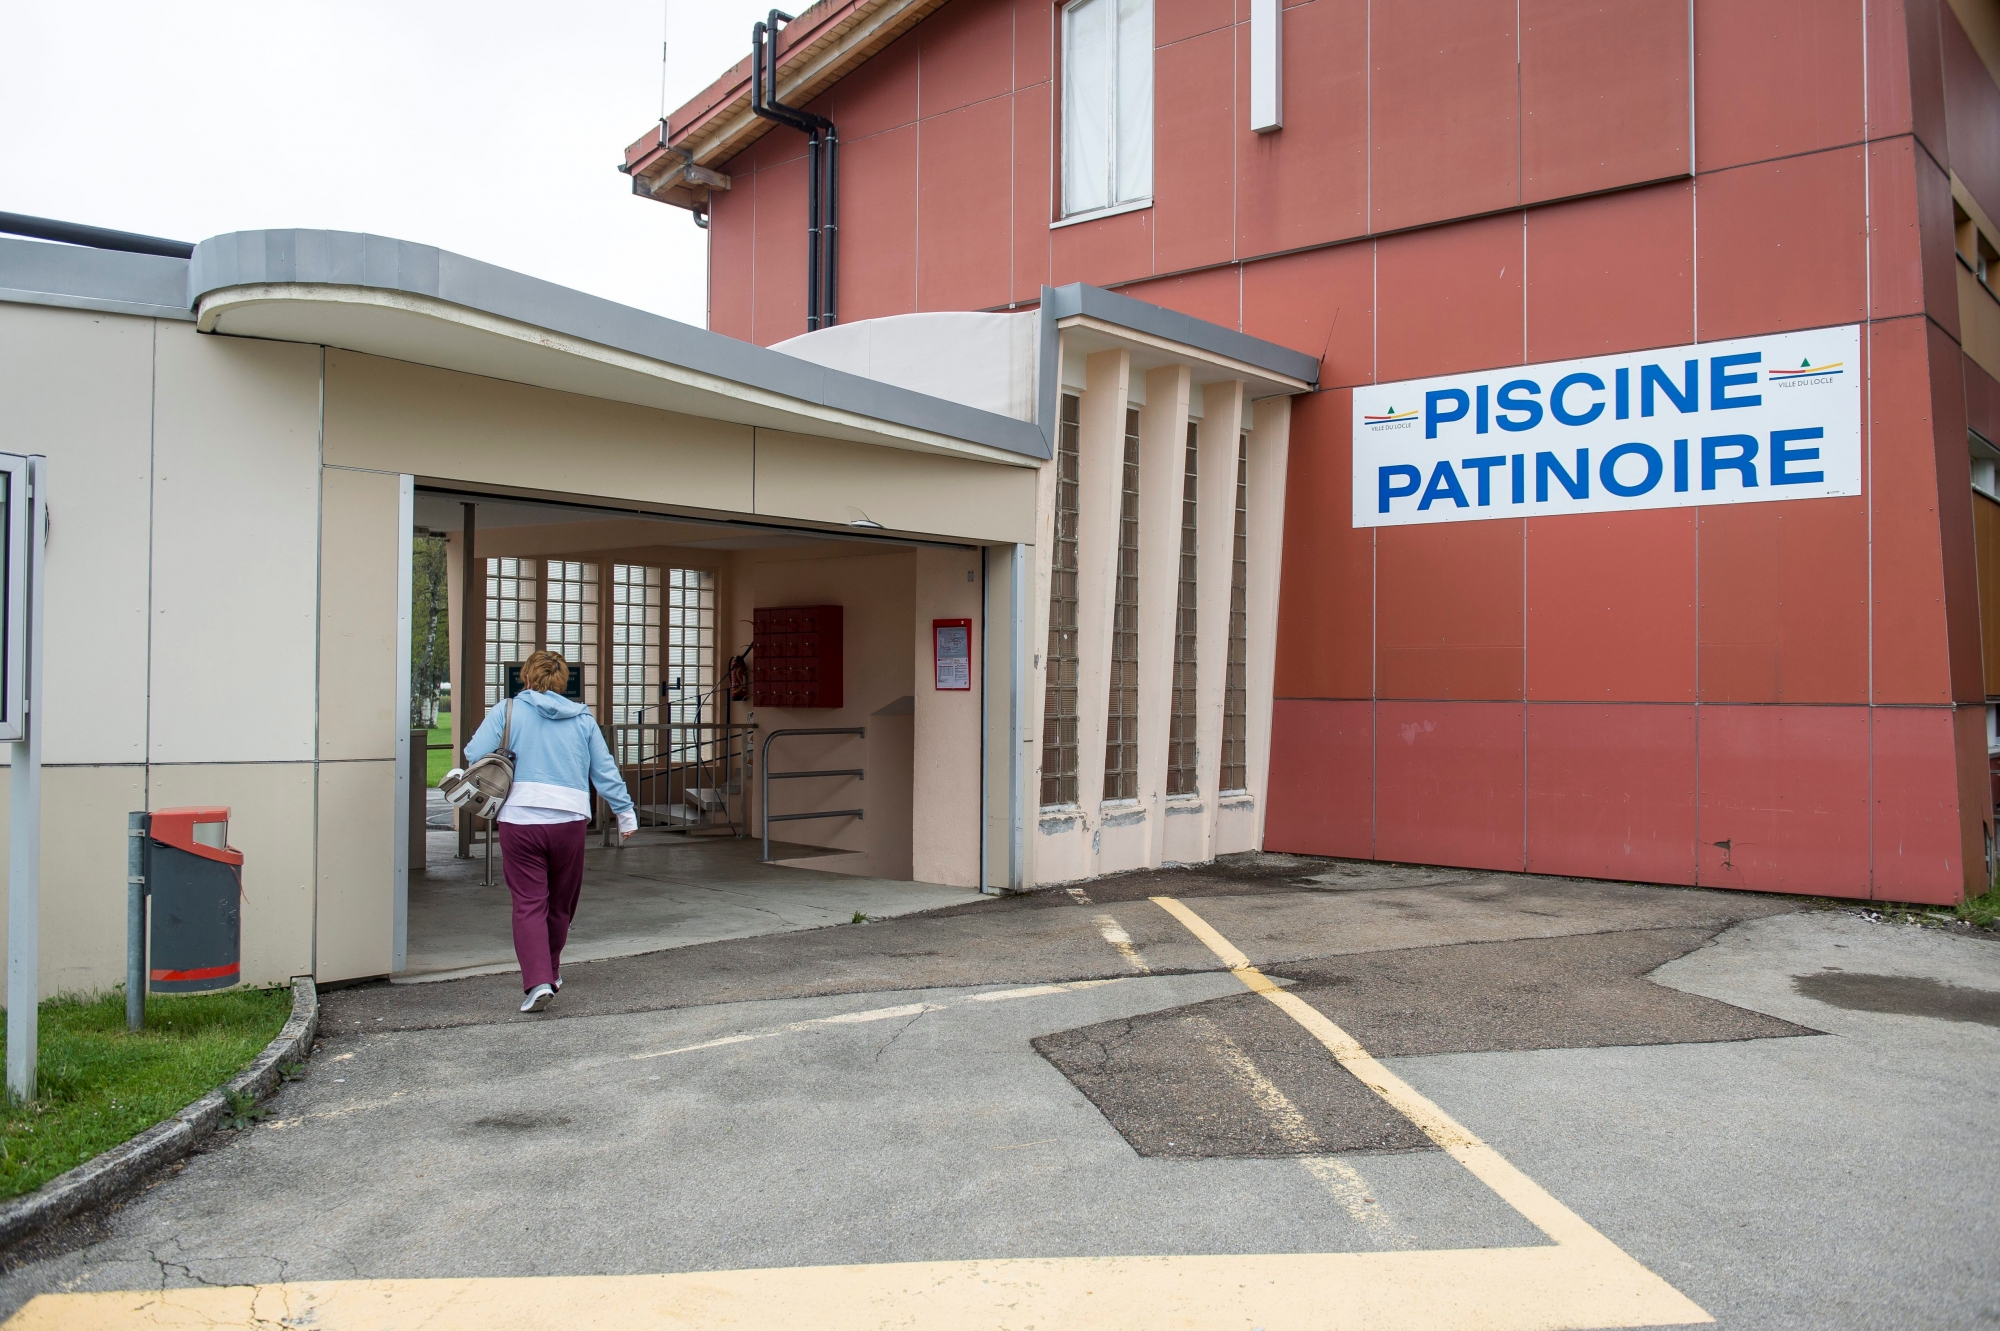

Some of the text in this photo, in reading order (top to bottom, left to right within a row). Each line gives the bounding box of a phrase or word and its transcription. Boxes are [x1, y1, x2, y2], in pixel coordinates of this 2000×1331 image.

[1425, 351, 1763, 439] PISCINE
[1778, 380, 1796, 388] VILLE
[1810, 377, 1833, 385] LOCLE
[1378, 426, 1825, 514] PATINOIRE
